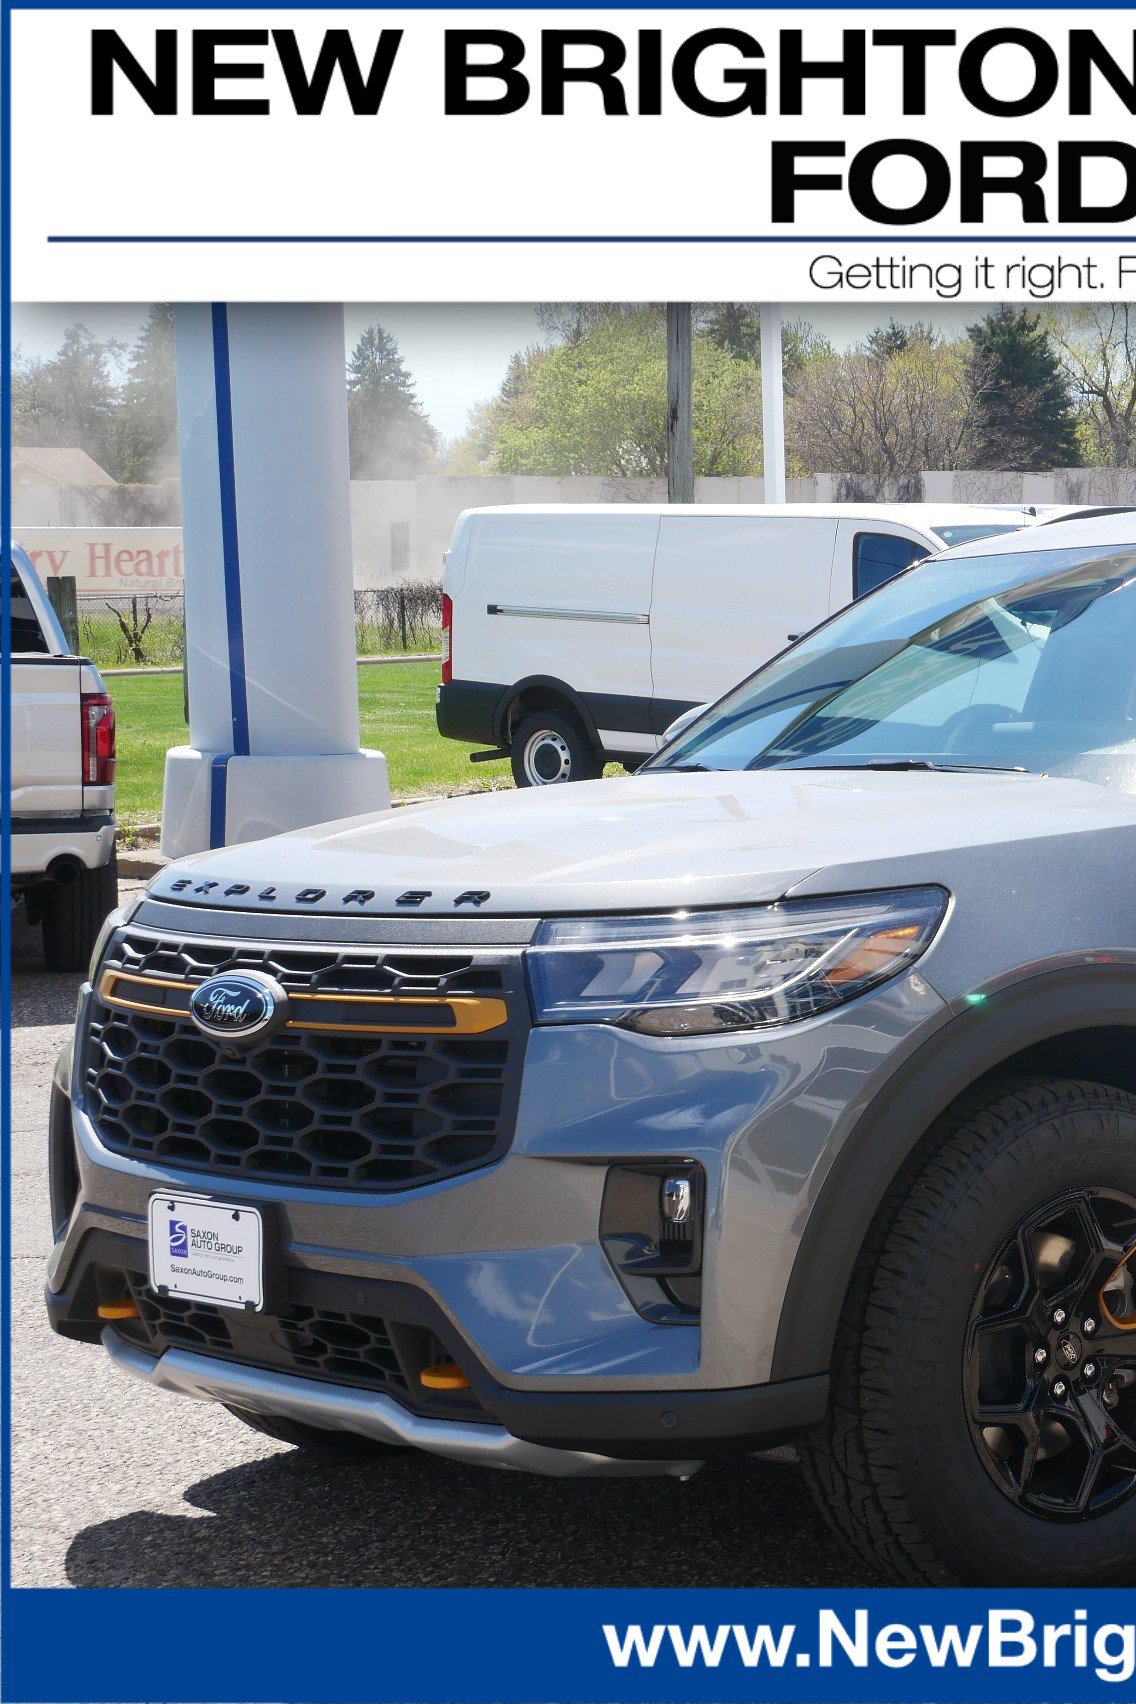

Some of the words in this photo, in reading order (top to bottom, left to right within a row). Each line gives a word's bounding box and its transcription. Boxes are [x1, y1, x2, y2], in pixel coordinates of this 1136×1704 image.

[85, 543, 184, 578] Heart
[170, 879, 491, 907] EXPLORER
[202, 987, 251, 1023] Ford
[190, 1228, 219, 1241] SAXON
[190, 1238, 213, 1251] AUTO
[214, 1242, 243, 1255] GROUP
[170, 1263, 244, 1284] SaxonAutoGroup.com
